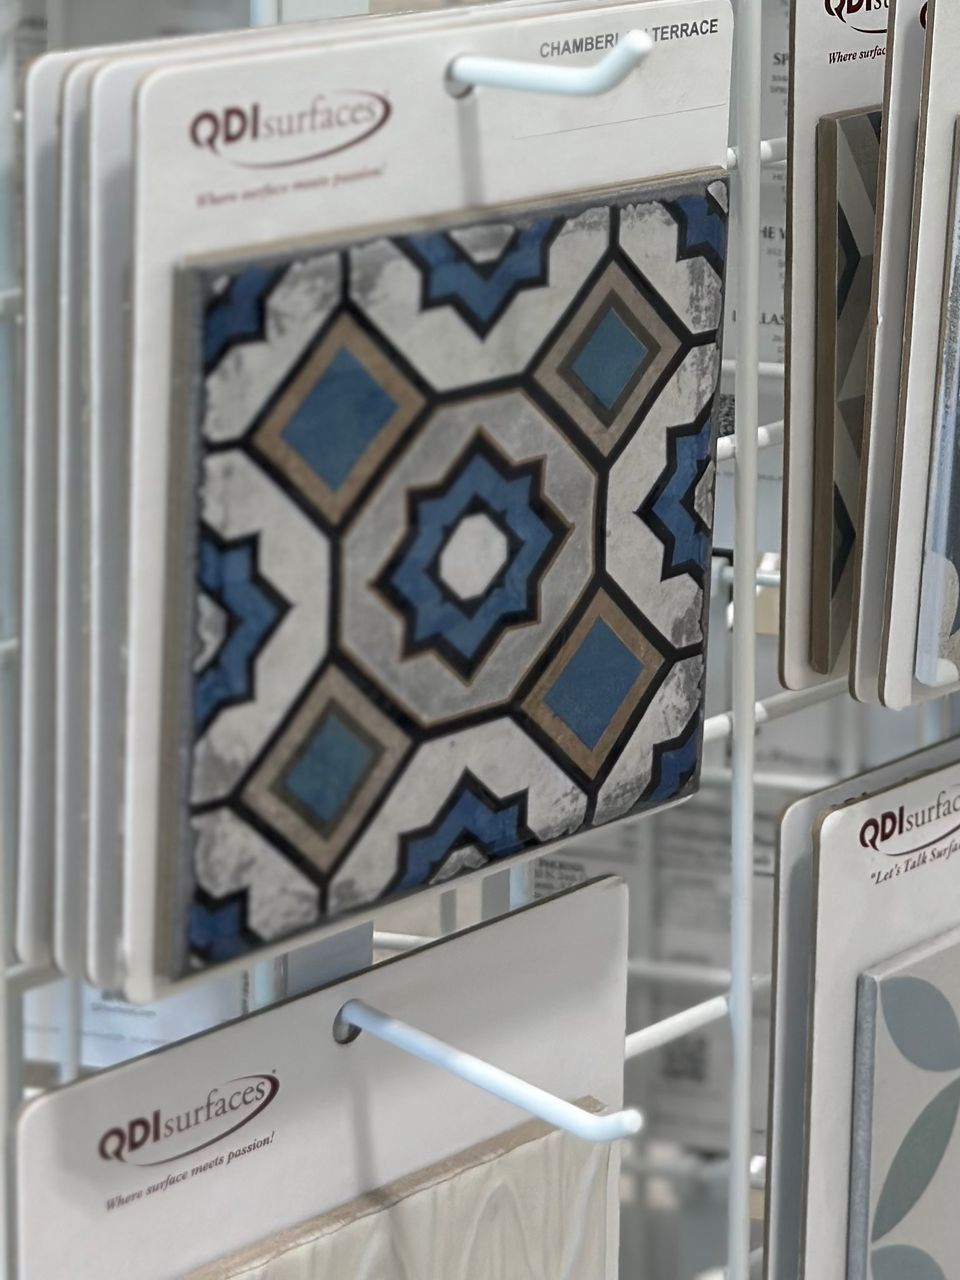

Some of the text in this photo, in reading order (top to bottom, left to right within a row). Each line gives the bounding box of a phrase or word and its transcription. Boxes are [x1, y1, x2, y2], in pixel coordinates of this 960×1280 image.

[652, 19, 719, 42] TERRACE
[829, 44, 886, 64] Where surfac
[870, 863, 901, 885] "Let's
[903, 851, 928, 874] Talk
[97, 1080, 267, 1163] QDIsurfaces
[105, 1129, 275, 1212] Where surface meets passion!
